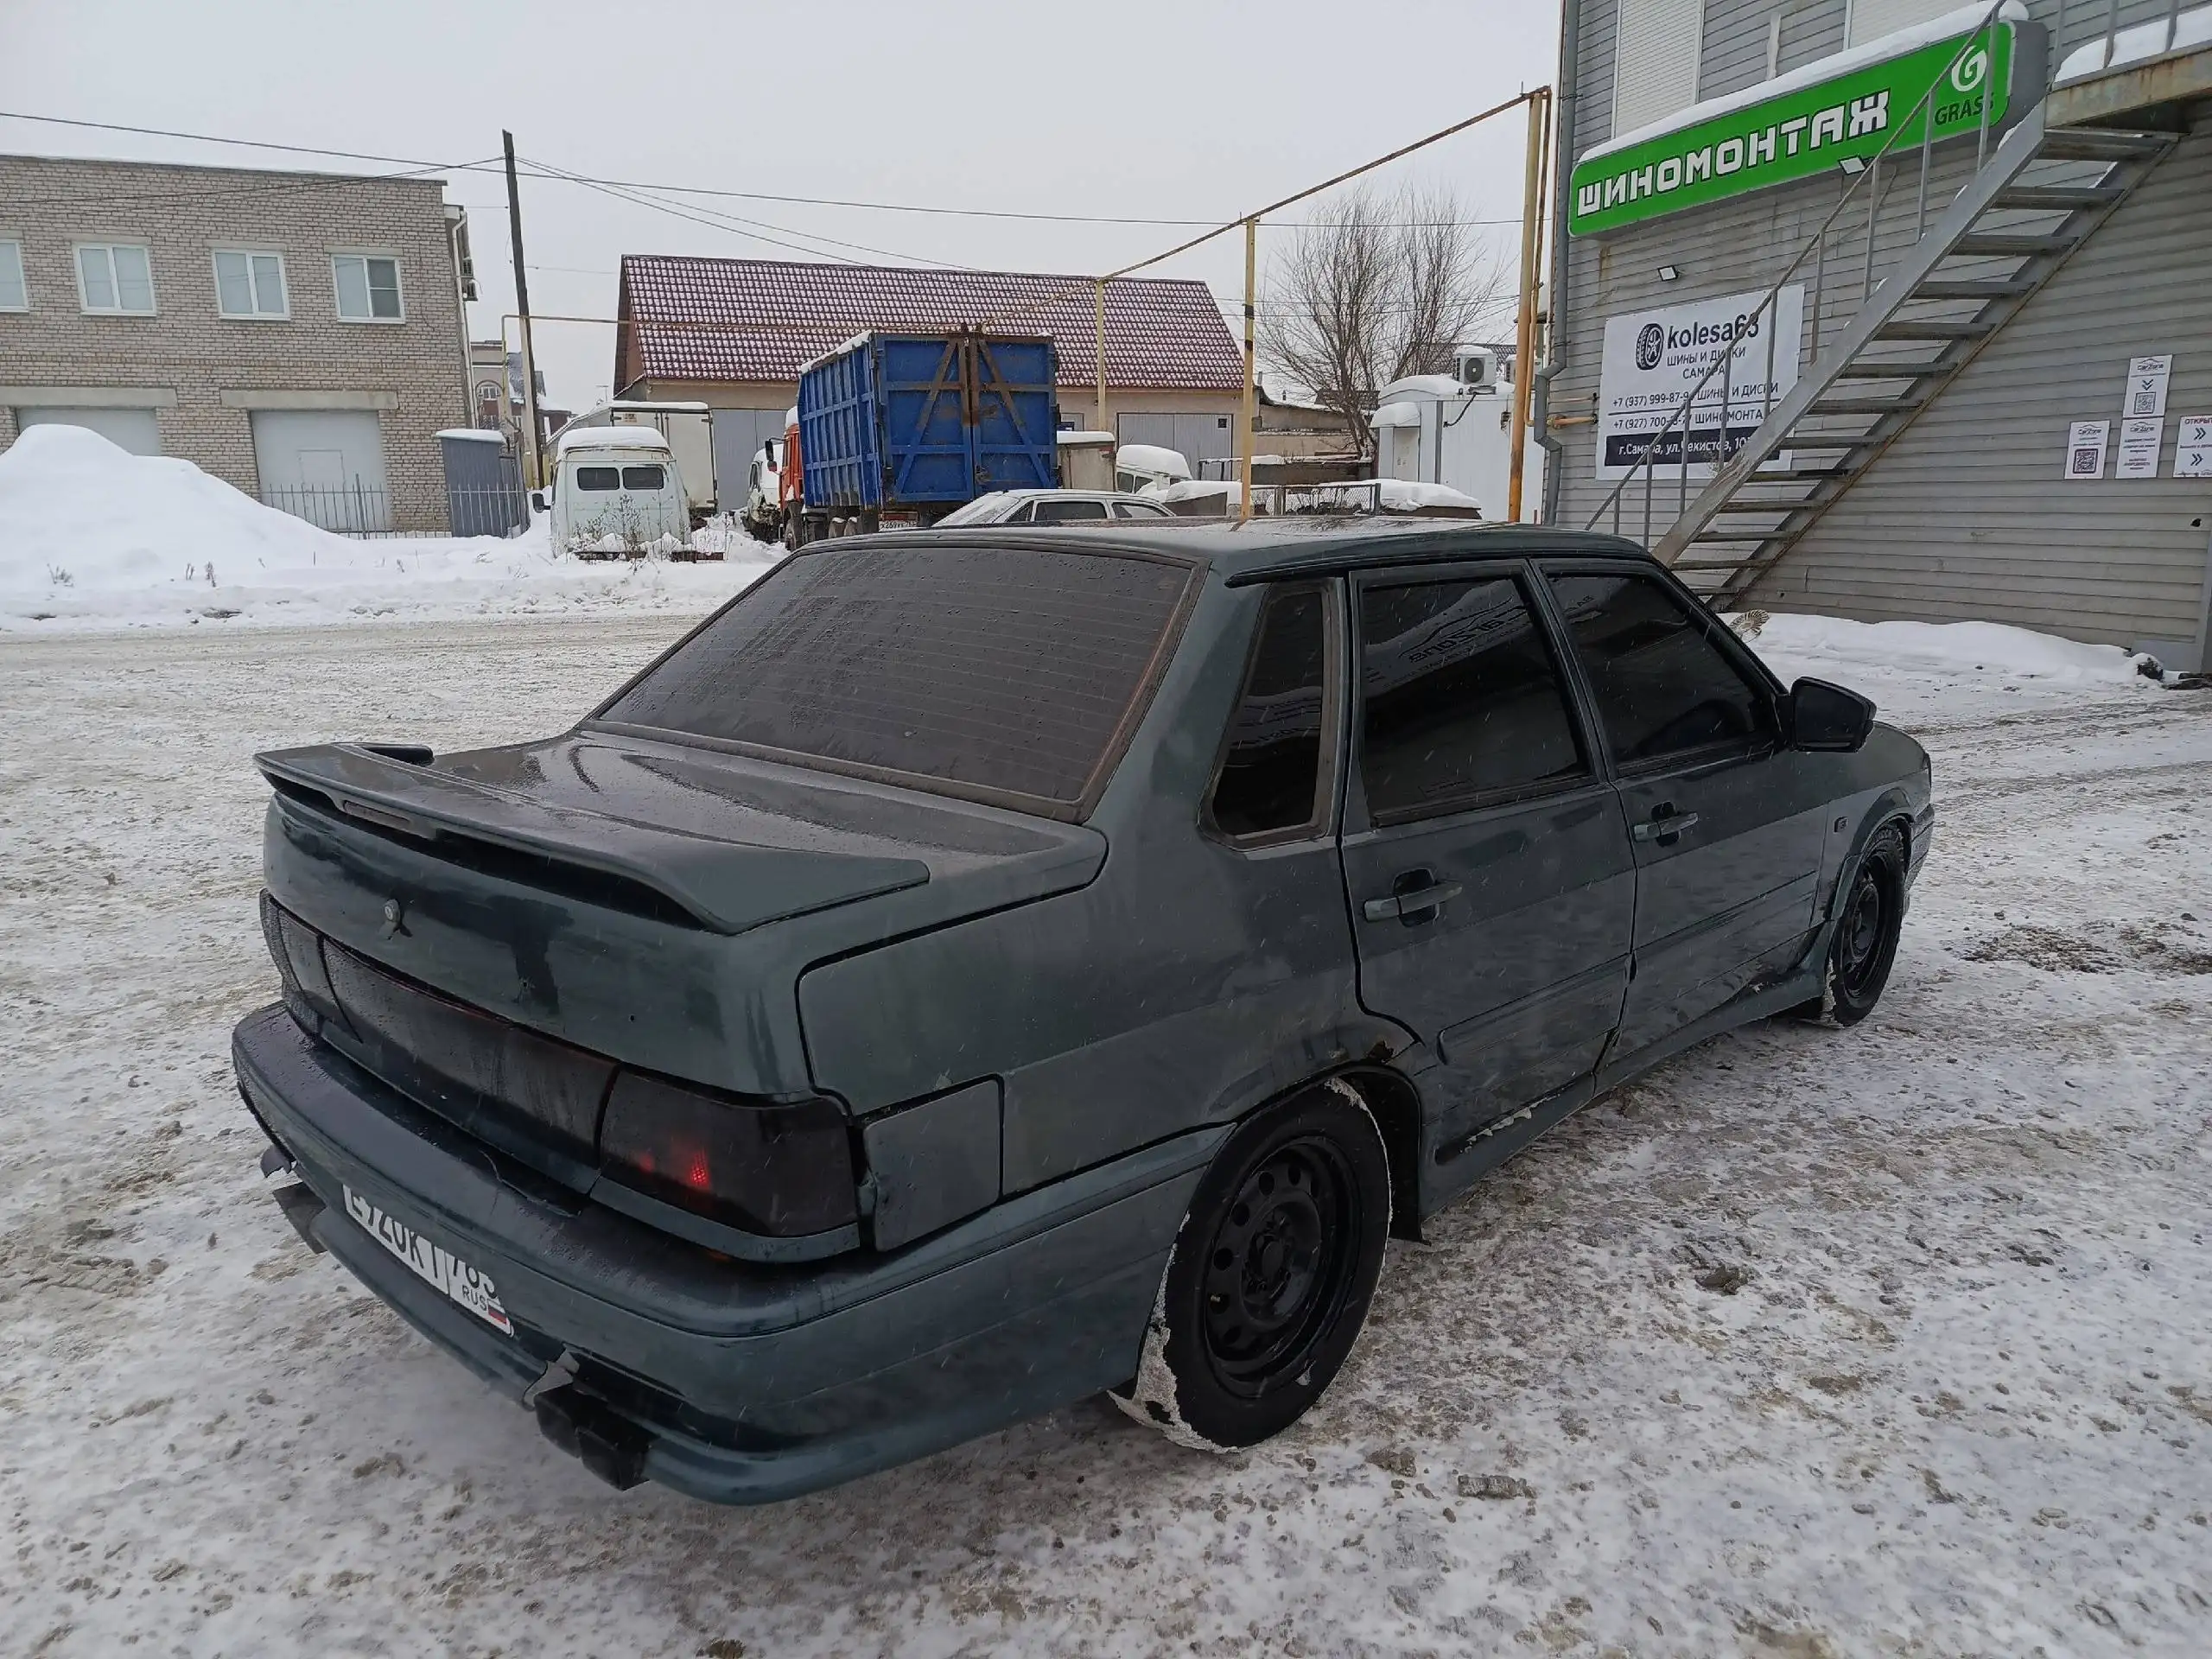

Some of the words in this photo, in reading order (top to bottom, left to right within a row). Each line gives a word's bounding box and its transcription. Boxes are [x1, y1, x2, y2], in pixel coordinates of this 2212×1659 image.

[1577, 87, 1890, 218] ШИНОМОНТАЖ
[1667, 352, 1698, 366] ШИНЫ
[1700, 349, 1707, 363] И
[1710, 346, 1746, 363] ДИКИ
[1613, 397, 1623, 407] +7
[1624, 396, 1648, 408] (937)
[1732, 386, 1739, 397] И
[1614, 419, 1624, 429] +7
[1625, 418, 1648, 429] (927)
[462, 1284, 487, 1312] RUS
